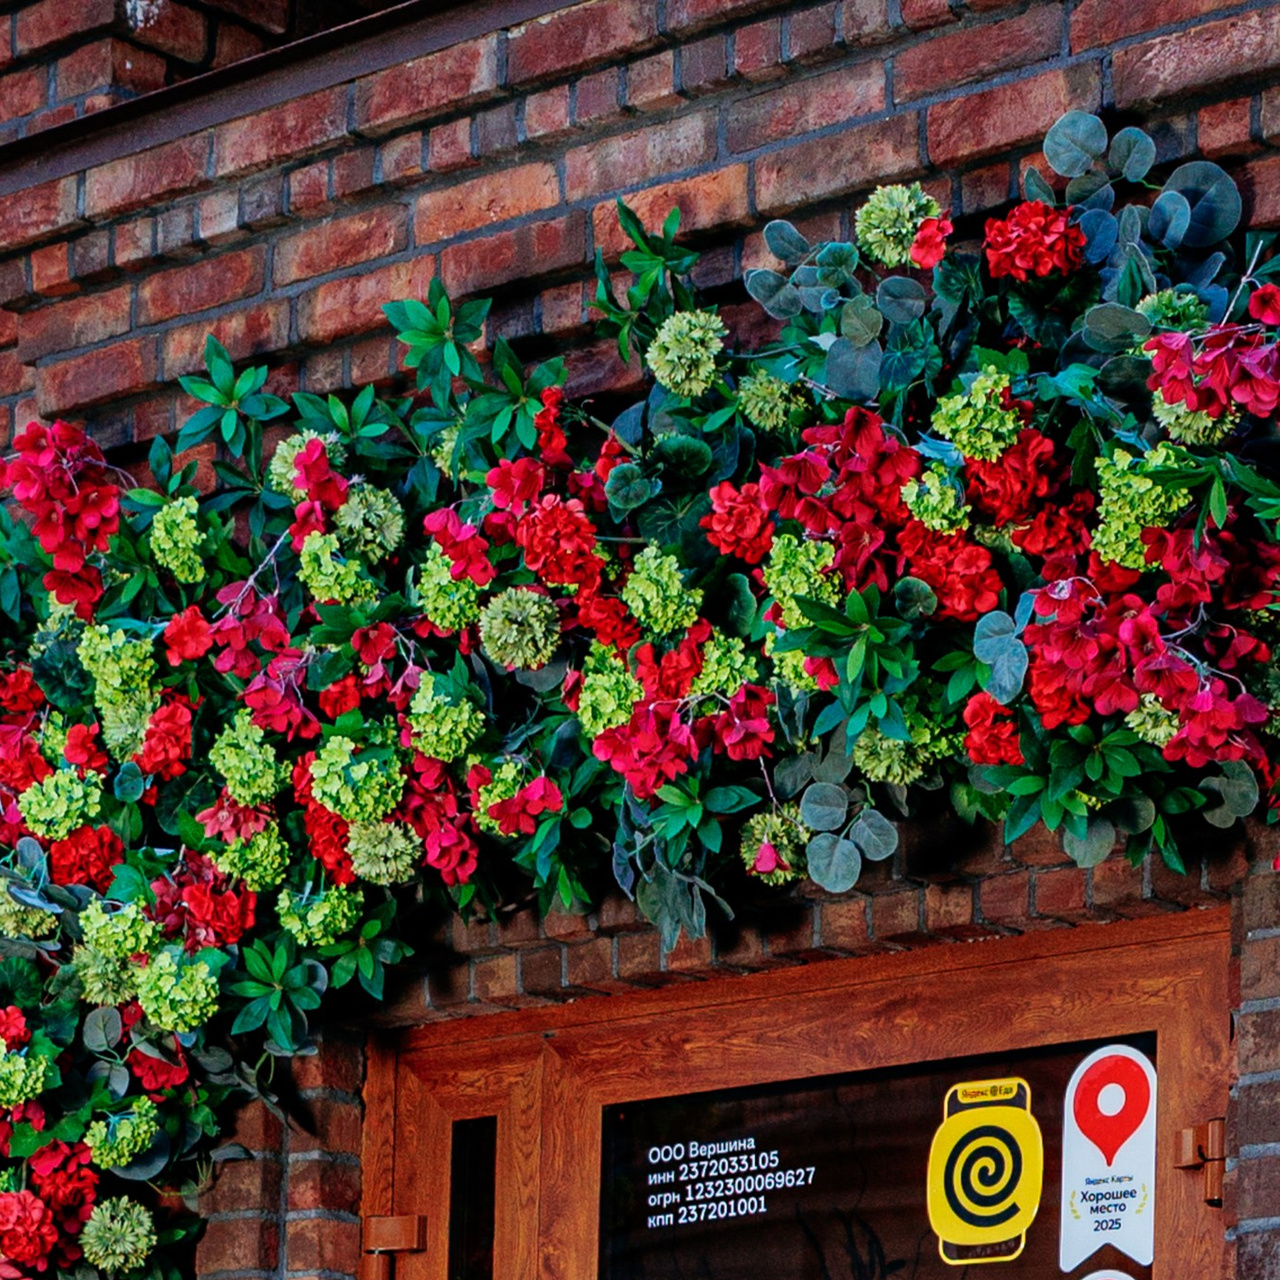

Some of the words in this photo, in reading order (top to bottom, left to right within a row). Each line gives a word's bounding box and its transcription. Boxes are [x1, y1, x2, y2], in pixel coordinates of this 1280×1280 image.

[648, 1143, 685, 1164] ООО
[689, 1137, 756, 1159] Вершина
[648, 1170, 675, 1186] инн
[679, 1151, 779, 1181] 2372033105
[648, 1191, 681, 1208] огрн
[685, 1167, 816, 1201] 1232300069627
[1080, 1188, 1137, 1204] Хорошее
[647, 1212, 674, 1229] кпп
[678, 1195, 767, 1224] 237201001
[1090, 1203, 1127, 1214] место
[1093, 1218, 1122, 1232] 2025
